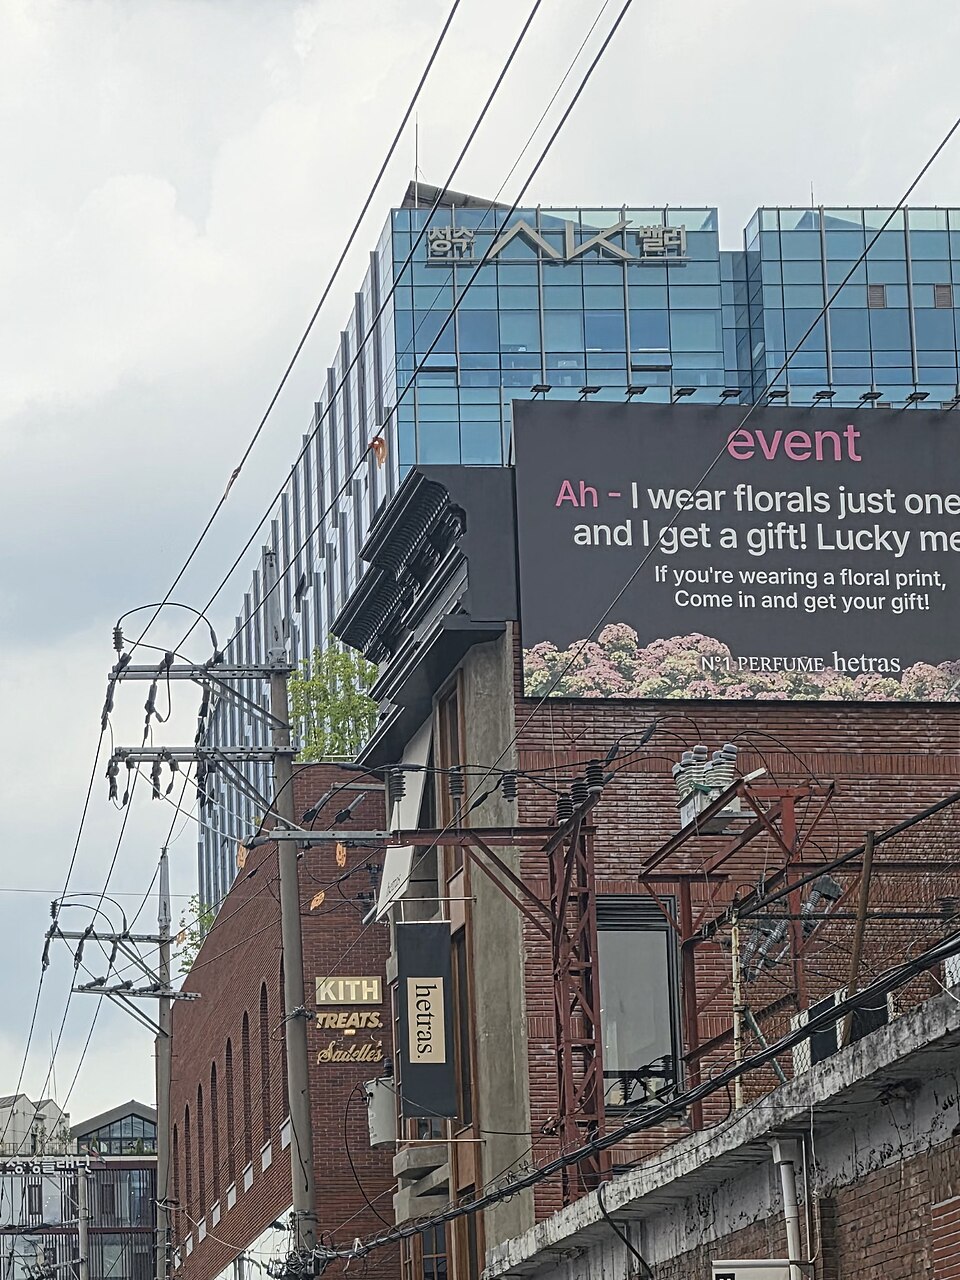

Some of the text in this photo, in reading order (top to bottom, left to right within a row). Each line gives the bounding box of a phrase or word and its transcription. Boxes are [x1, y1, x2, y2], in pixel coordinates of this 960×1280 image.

[727, 424, 862, 462] event
[555, 479, 599, 507] Ah
[631, 482, 638, 509] I
[647, 487, 726, 511] wear
[734, 484, 831, 513] florals
[838, 485, 896, 520] just
[904, 492, 960, 515] one
[573, 519, 632, 546] and
[642, 520, 649, 547] I
[658, 521, 711, 555] get
[719, 527, 737, 549] a
[746, 521, 807, 558] gift!
[817, 523, 910, 558] Lucky
[654, 565, 947, 591] If you're wearing a floral print,
[674, 590, 930, 614] Come in and get your gift!
[737, 656, 825, 673] PERFUME
[318, 979, 379, 1001] KITH
[316, 1010, 384, 1030] TREATS.
